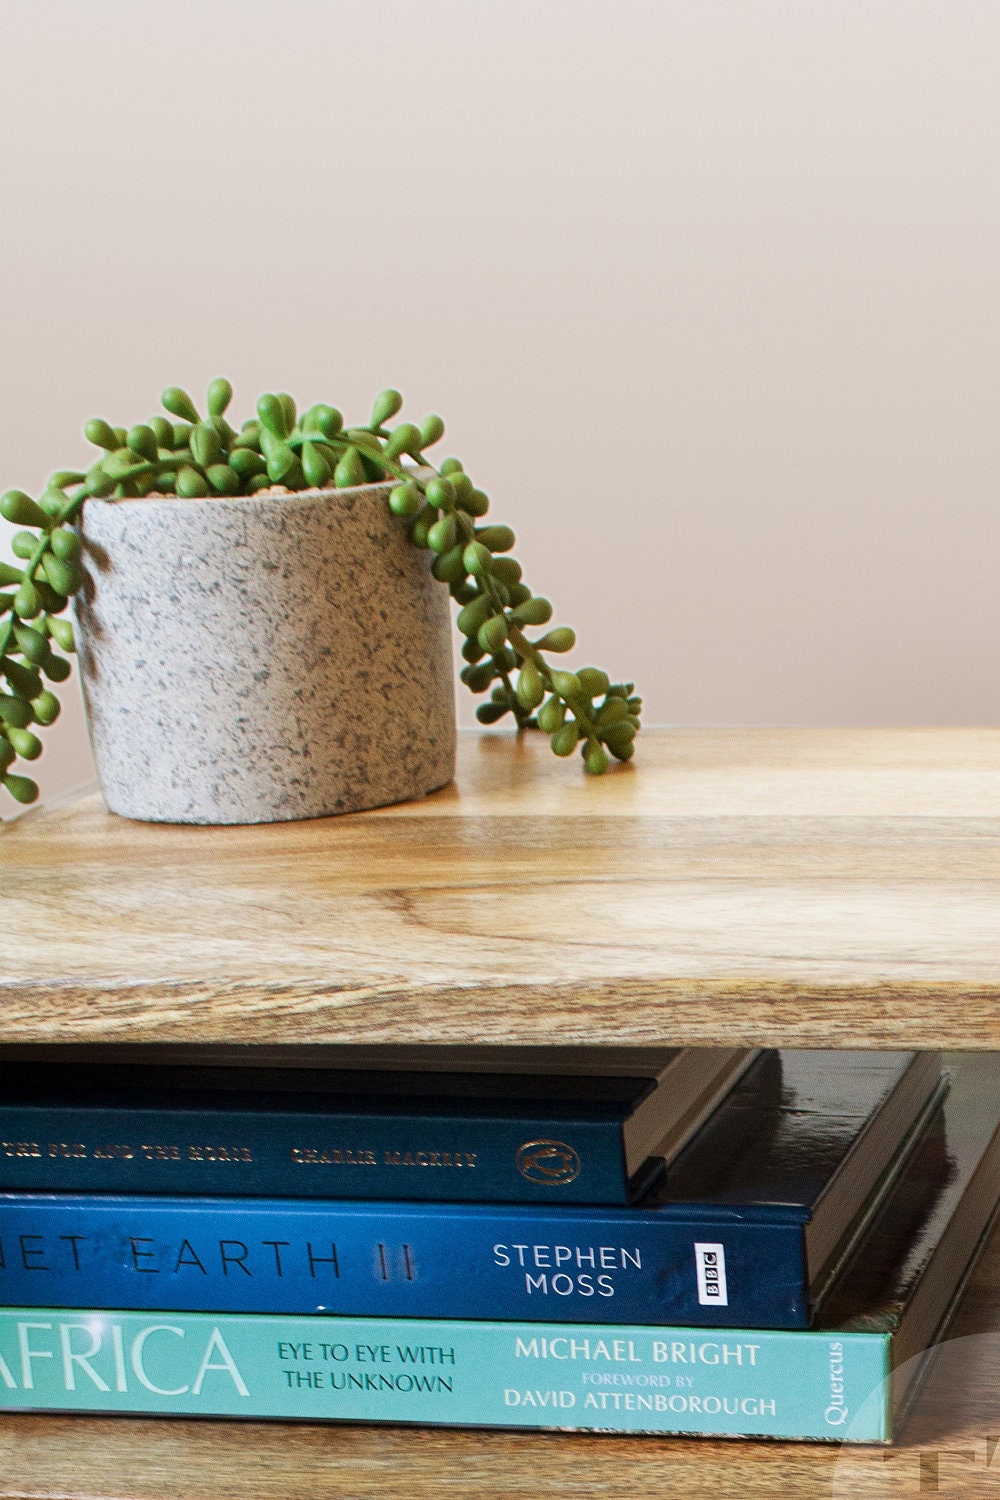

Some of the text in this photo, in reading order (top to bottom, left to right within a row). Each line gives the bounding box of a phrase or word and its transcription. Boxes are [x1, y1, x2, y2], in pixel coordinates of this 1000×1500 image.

[0, 1234, 414, 1281] ET EARTH II
[493, 1244, 642, 1269] STEPHEN
[525, 1274, 616, 1297] MOSS
[703, 1252, 720, 1297] BBC
[278, 1342, 456, 1365] EYE TO EYE WITH
[515, 1337, 760, 1366] MICHAEL BRIGHT
[284, 1370, 454, 1393] THE UNKNOWN
[582, 1371, 695, 1388] FOREWORD BY
[824, 1341, 848, 1426] Quercus
[504, 1388, 776, 1416] DAVID ATTENBOROUGH
